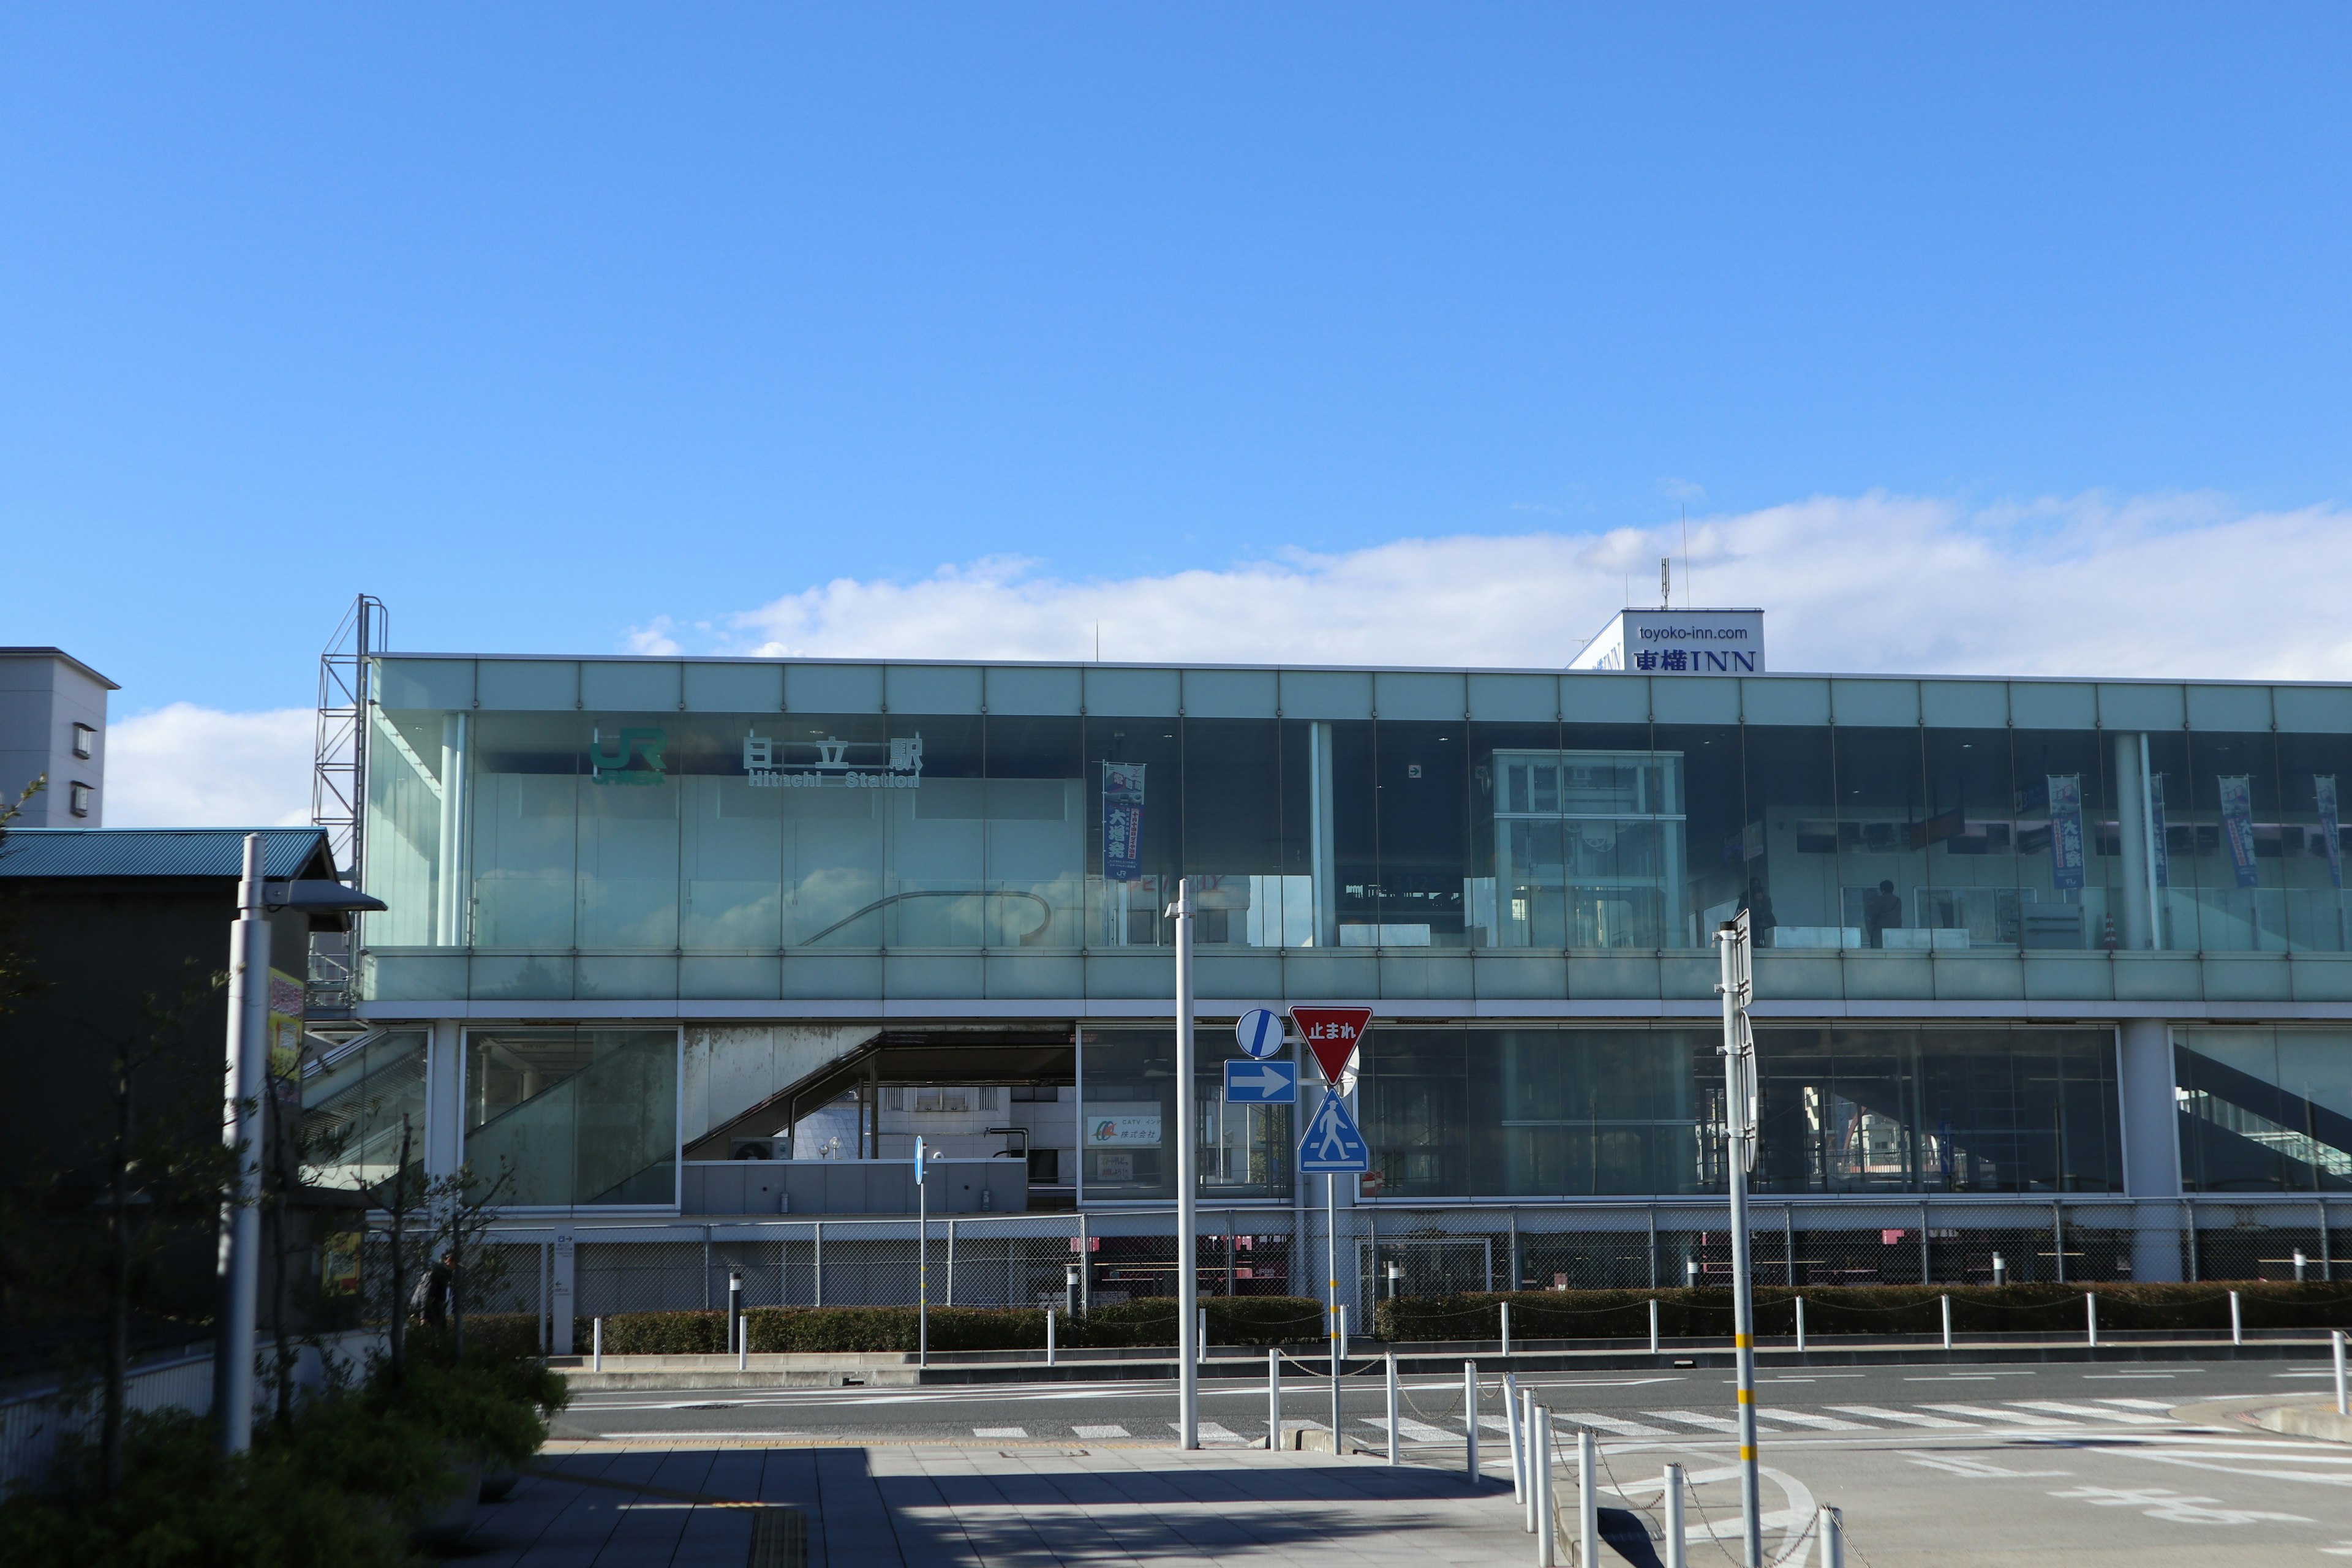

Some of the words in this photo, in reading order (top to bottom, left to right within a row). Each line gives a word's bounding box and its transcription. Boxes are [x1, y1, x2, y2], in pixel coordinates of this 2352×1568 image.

[1639, 626, 1748, 642] toyoko-inn.com
[1634, 649, 1757, 671] 東横INN
[590, 727, 668, 769] JR
[743, 736, 923, 771] 日立駅
[748, 770, 821, 787] Hitachi
[845, 771, 919, 788] Station
[1108, 809, 1126, 858] 大増発
[1308, 1022, 1356, 1039] 止まれ
[1121, 1130, 1156, 1139] 株式会社
